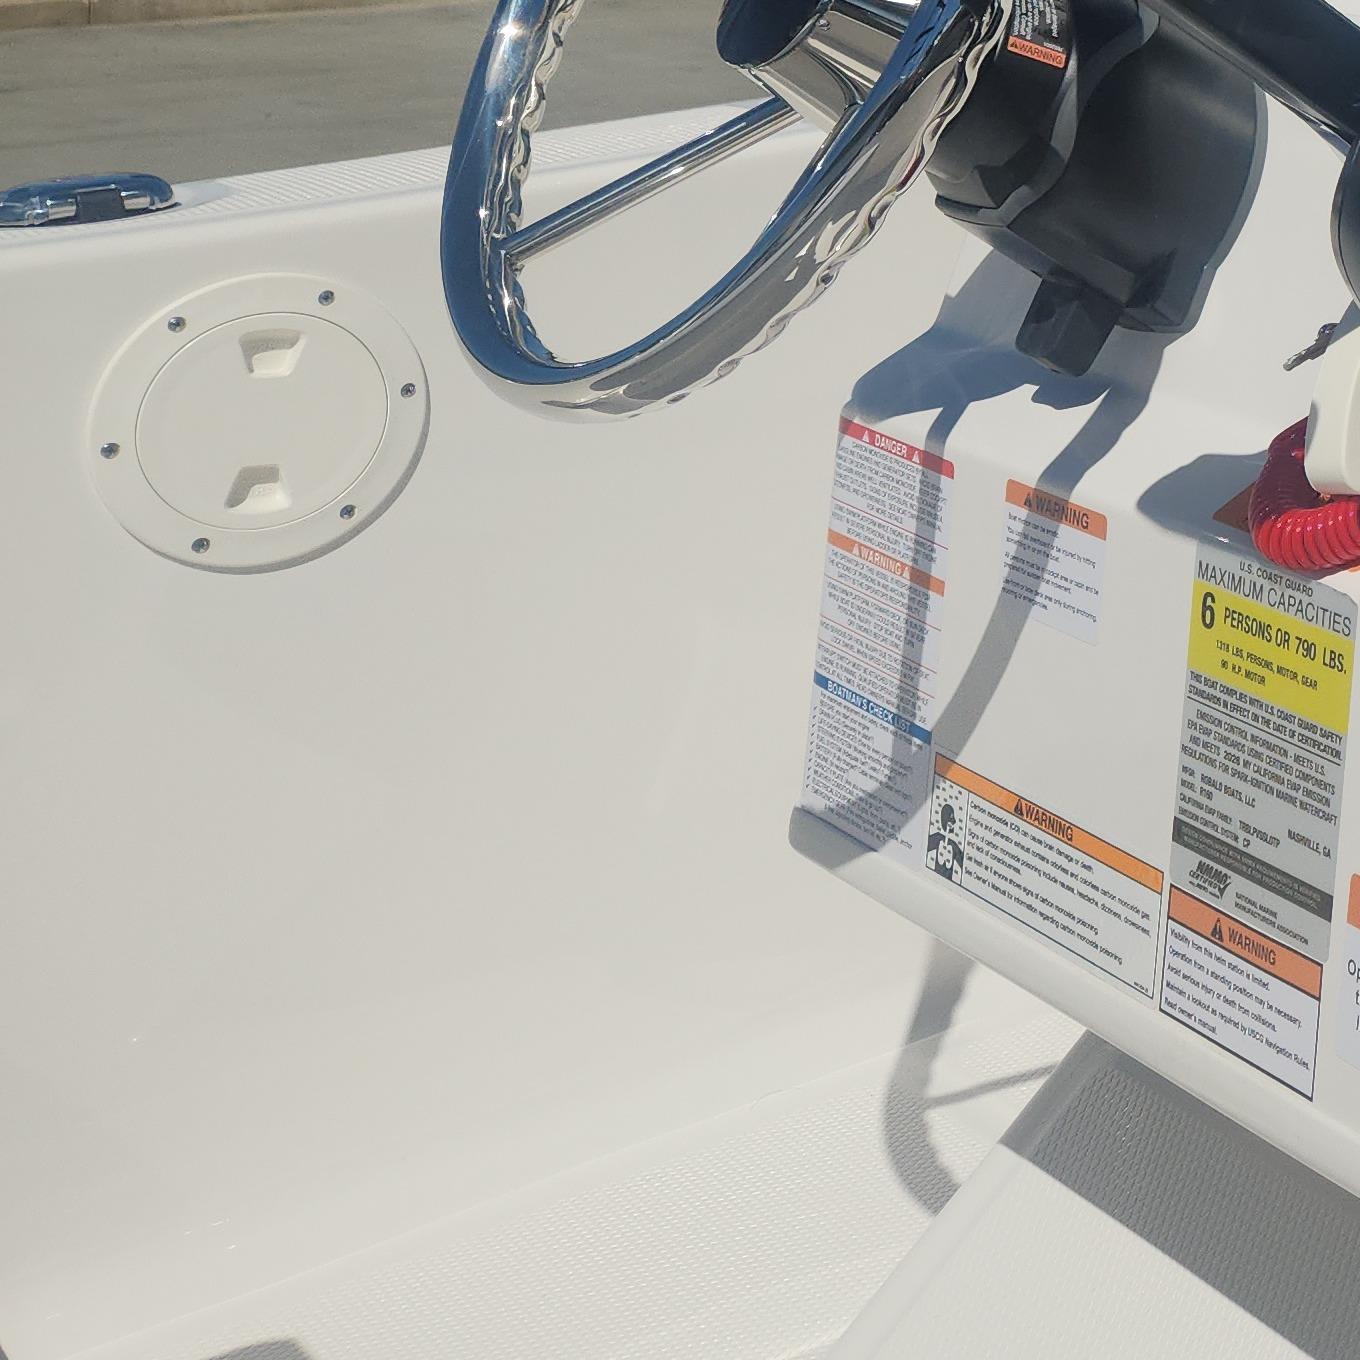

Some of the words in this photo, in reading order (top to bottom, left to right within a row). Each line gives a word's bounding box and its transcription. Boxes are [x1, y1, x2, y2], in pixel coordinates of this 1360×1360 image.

[1018, 44, 1062, 64] WARNING
[875, 434, 908, 458] DANGER
[1030, 493, 1091, 530] WARNING
[861, 546, 902, 575] WARNING
[1239, 560, 1255, 576] U.S.
[1256, 568, 1284, 588] COAST
[1285, 578, 1314, 598] GUARD
[1196, 560, 1264, 604] MAXIMUM
[1266, 586, 1352, 638] CAPACITIES
[1199, 589, 1217, 631] 6
[1223, 606, 1273, 643] PERSONS
[1274, 627, 1290, 651] OR
[1294, 636, 1316, 661] 790
[1322, 647, 1347, 674] LBS.
[1024, 803, 1073, 841] WARNING
[1228, 926, 1277, 965] WARNING
